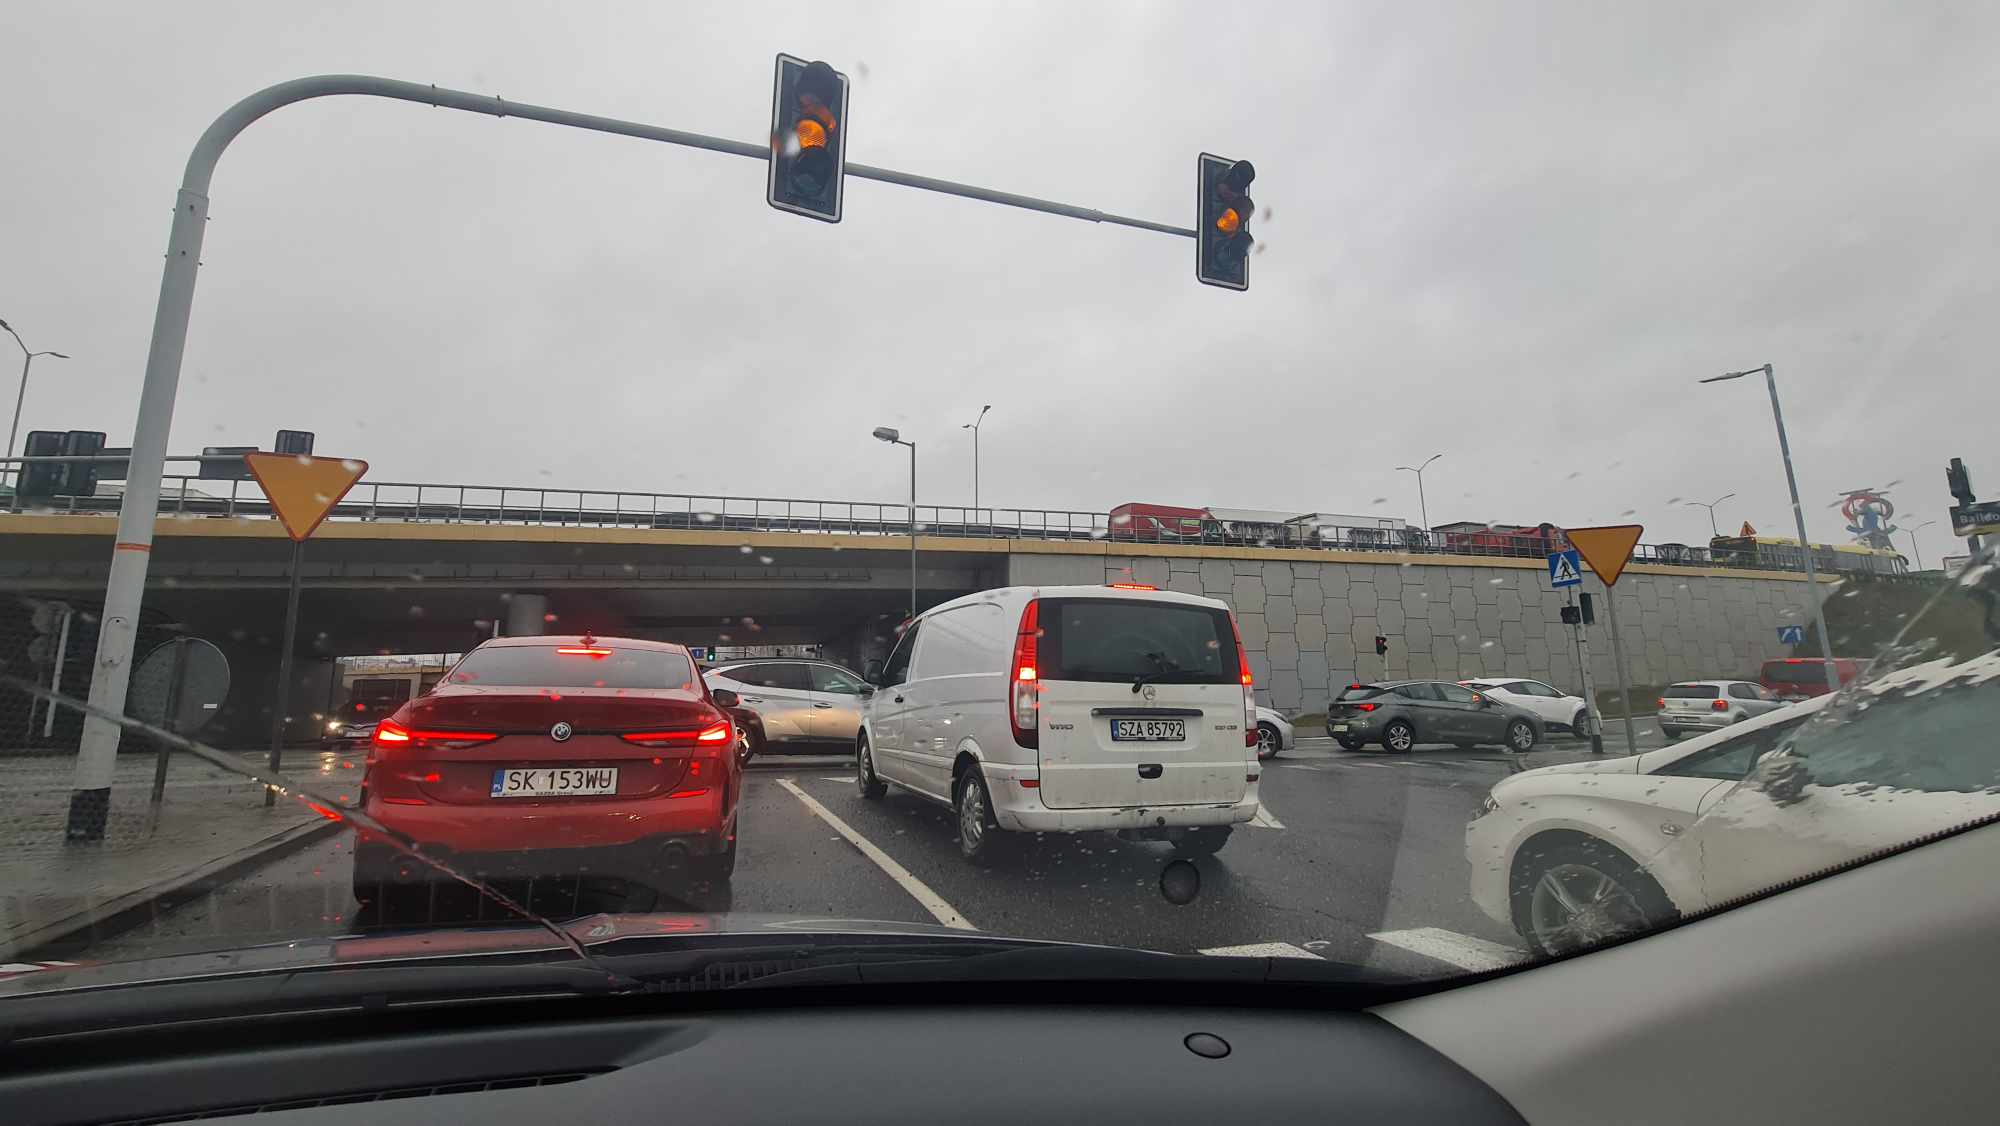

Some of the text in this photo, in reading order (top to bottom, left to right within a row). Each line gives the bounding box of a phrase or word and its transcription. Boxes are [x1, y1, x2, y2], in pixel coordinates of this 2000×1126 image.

[1120, 721, 1183, 737] SZA 85792
[508, 769, 612, 791] SK 153WU
